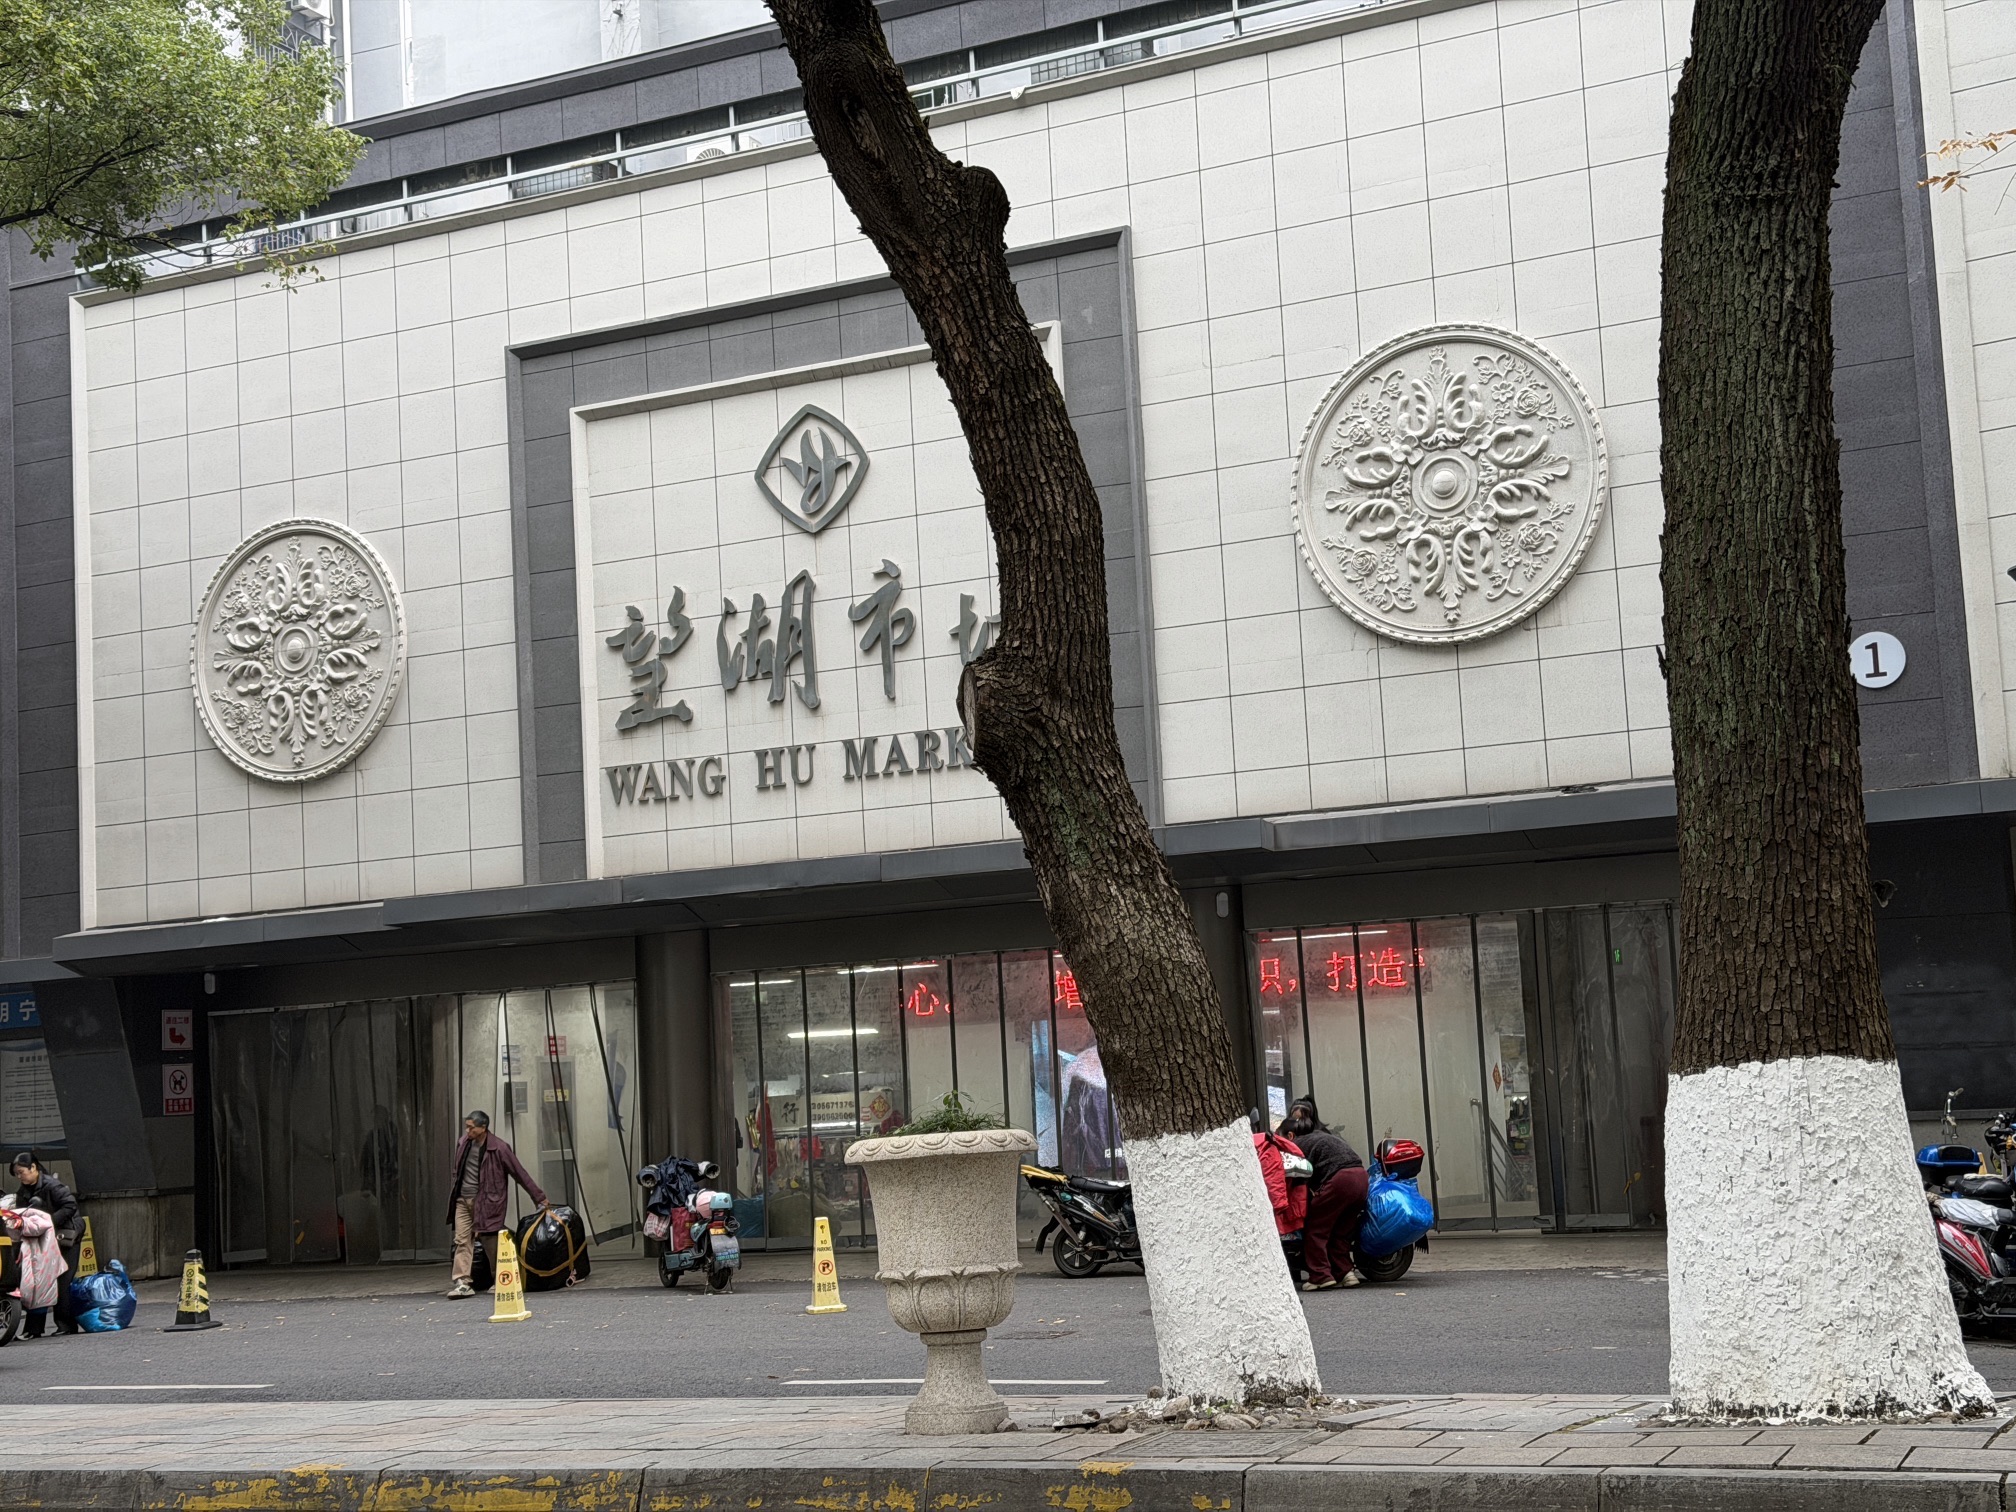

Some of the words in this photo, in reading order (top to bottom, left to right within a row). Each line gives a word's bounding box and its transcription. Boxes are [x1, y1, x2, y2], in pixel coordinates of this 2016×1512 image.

[1864, 641, 1888, 679] 1
[605, 755, 727, 805] WANG
[754, 742, 816, 790] HU
